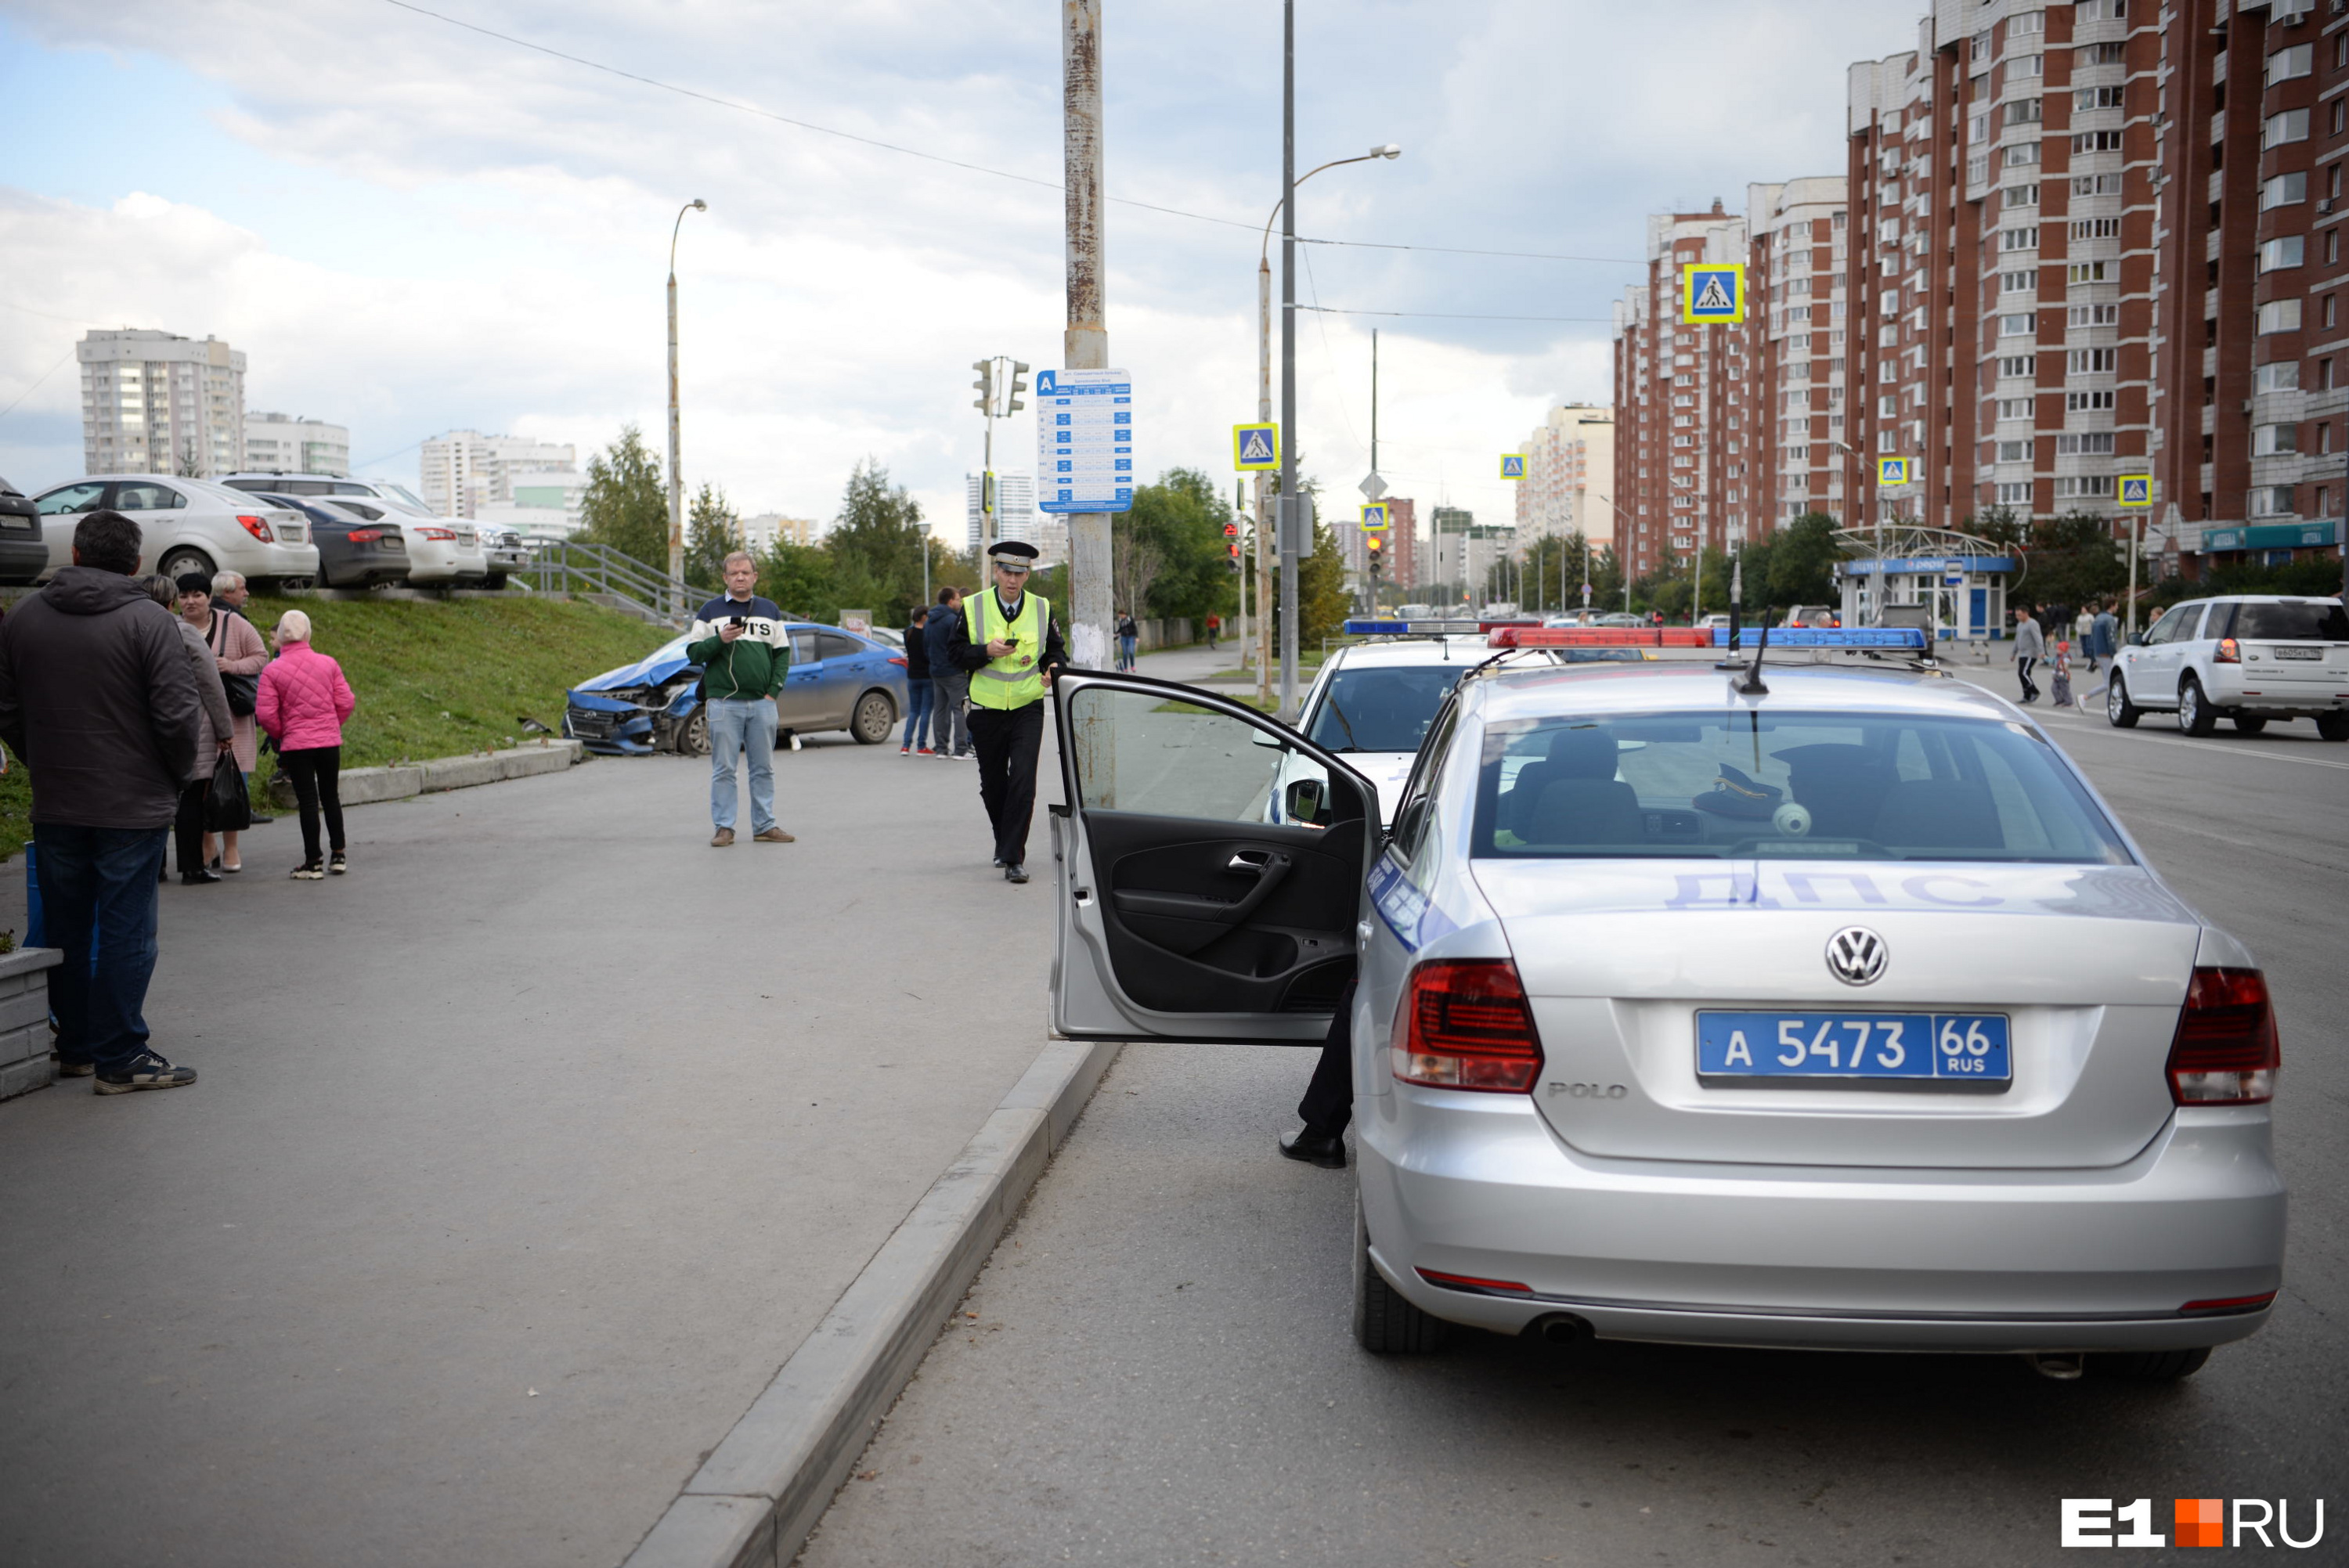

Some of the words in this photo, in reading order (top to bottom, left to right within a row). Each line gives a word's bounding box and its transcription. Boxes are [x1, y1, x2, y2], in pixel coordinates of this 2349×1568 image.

[2213, 533, 2236, 547] АПТЕКА
[1663, 873, 2006, 910] ДПС
[1724, 1031, 1752, 1066] А
[1777, 1021, 1906, 1069] 5473
[1940, 1020, 1990, 1057] 66
[1947, 1058, 1986, 1073] RUS
[1548, 1082, 1628, 1100] POLO
